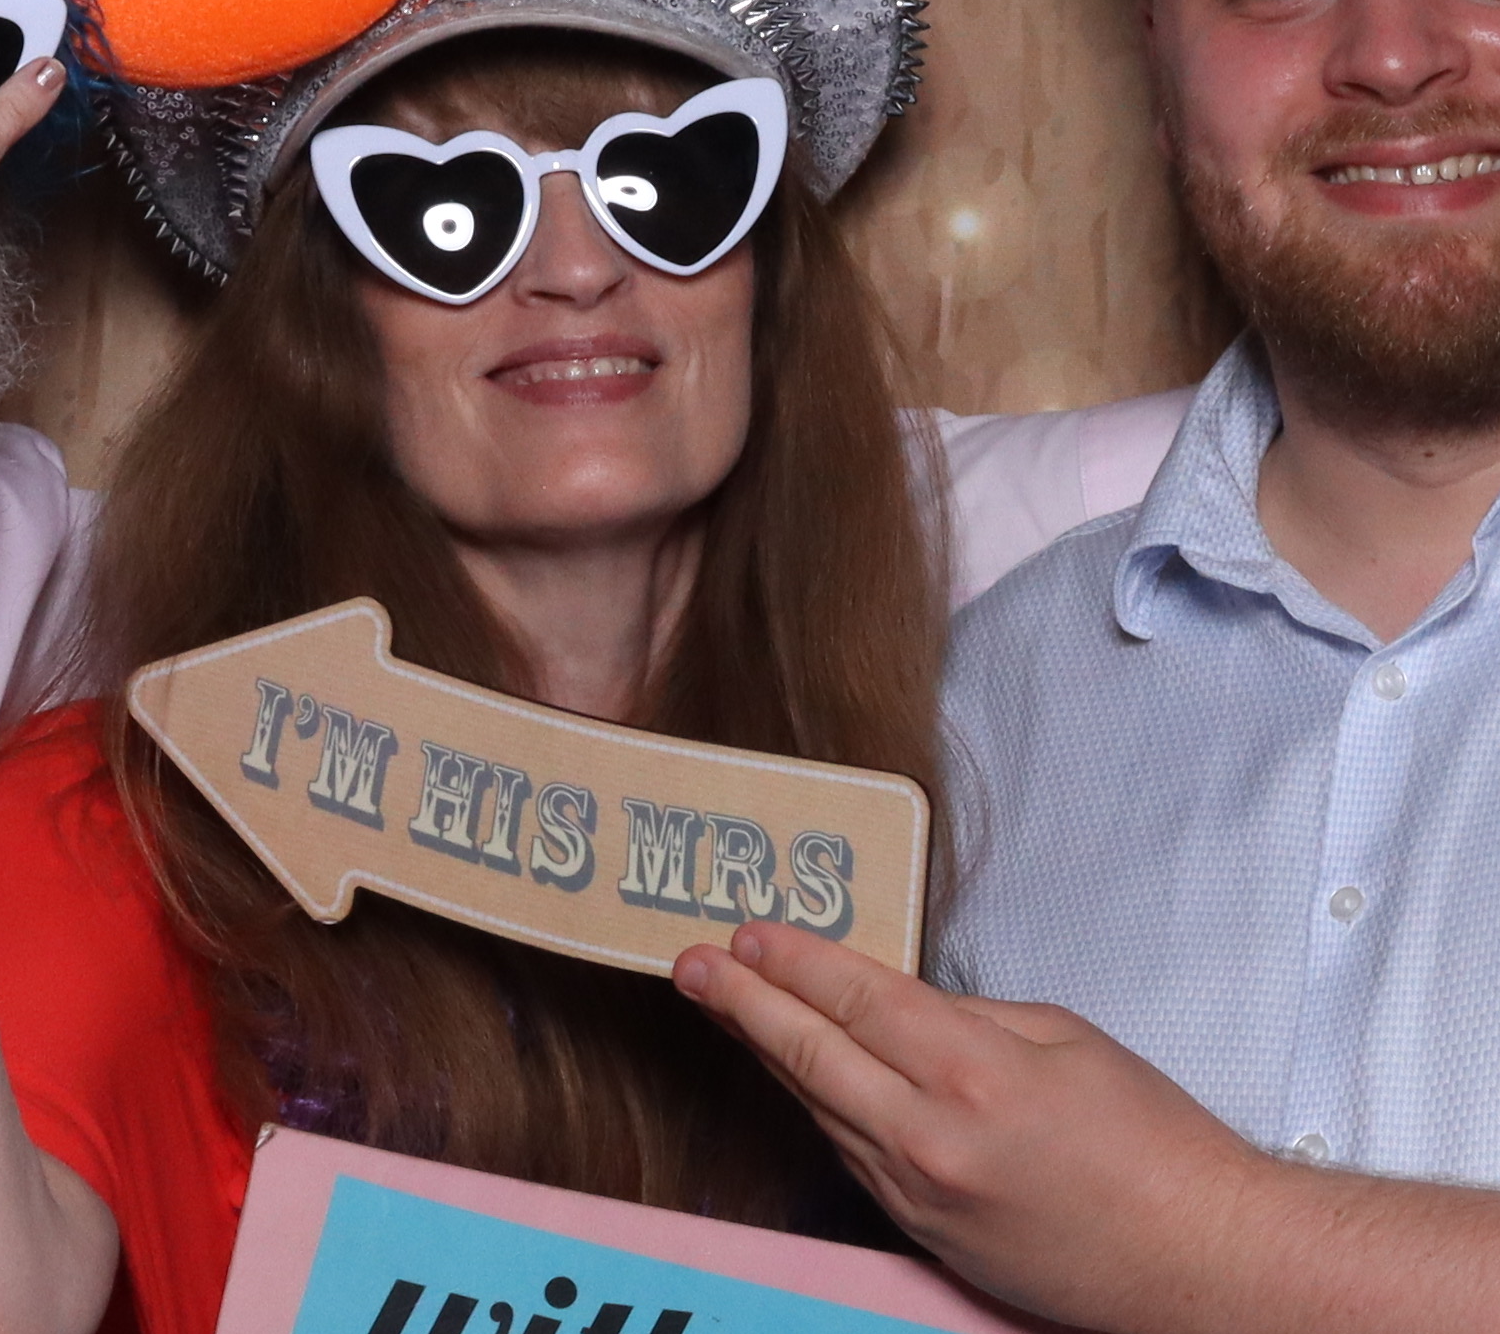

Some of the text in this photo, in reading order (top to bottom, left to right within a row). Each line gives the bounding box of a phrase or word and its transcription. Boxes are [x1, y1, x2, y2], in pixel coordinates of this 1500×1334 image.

[240, 678, 854, 941] I'M HIS MRS
